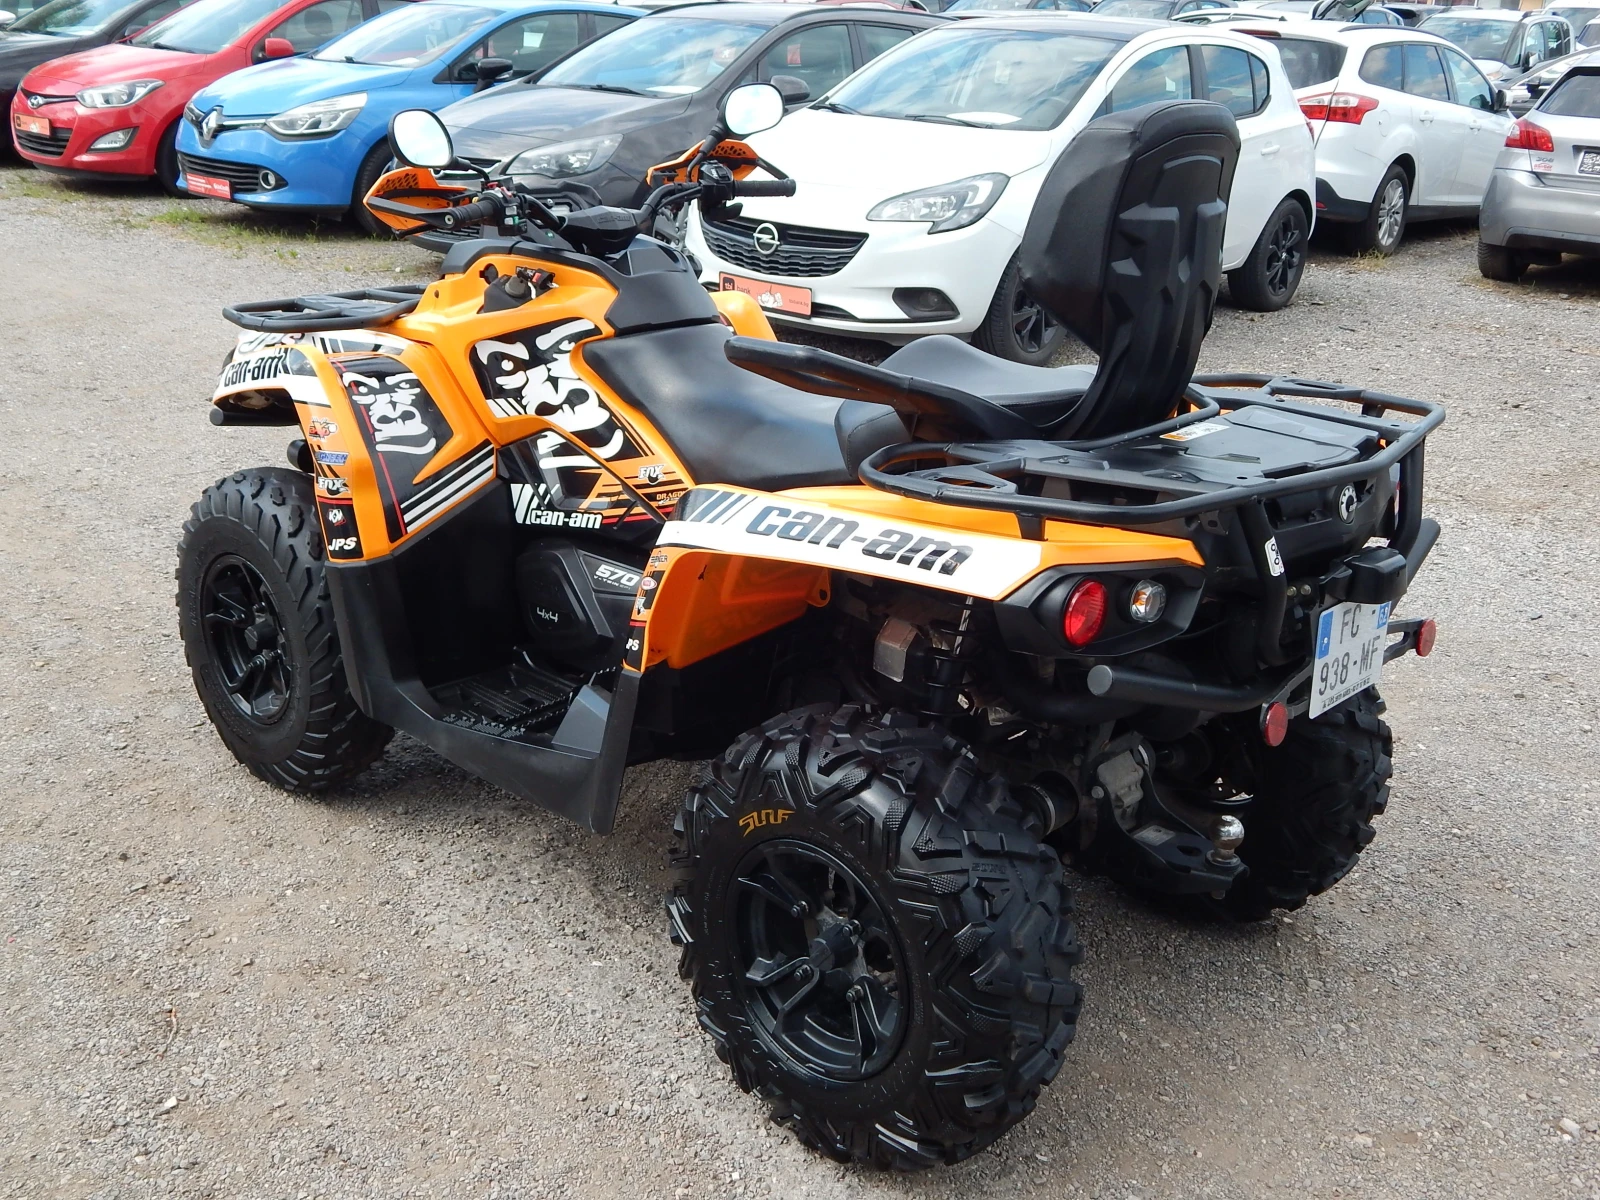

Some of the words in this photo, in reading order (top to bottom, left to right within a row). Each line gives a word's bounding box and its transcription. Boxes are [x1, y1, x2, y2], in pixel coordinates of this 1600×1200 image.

[736, 284, 751, 294] bank
[223, 353, 284, 388] can-am
[530, 509, 603, 529] can-am
[328, 537, 357, 551] JPS
[745, 505, 973, 577] can-am
[595, 564, 640, 587] 570
[536, 606, 559, 623] 4x4
[1340, 604, 1362, 645] FC
[1318, 635, 1380, 696] 938-MF
